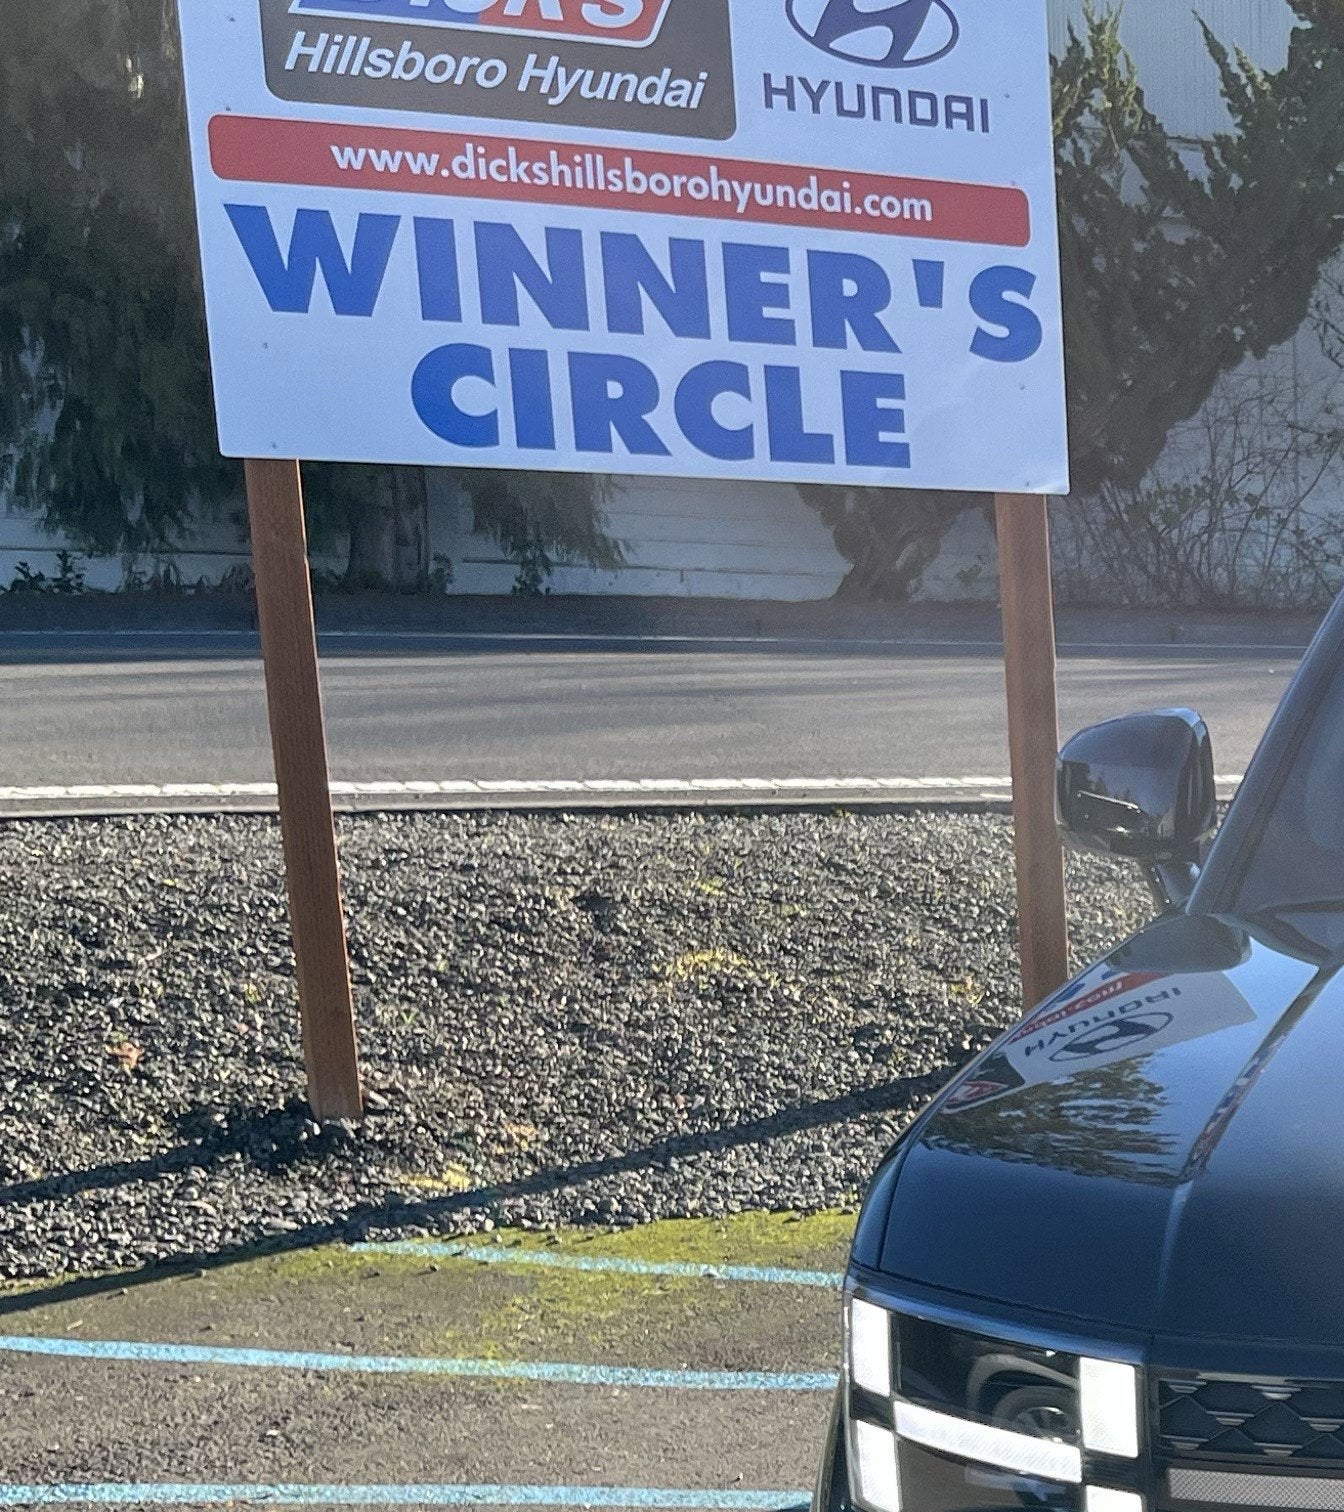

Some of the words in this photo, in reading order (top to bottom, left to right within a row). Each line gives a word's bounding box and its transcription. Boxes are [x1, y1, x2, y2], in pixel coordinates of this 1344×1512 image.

[284, 30, 507, 88] Hillsboro
[517, 54, 708, 109] Hyundai
[763, 72, 989, 134] HYUNDAI
[330, 140, 933, 222] www.dickshillsborohyundai.com
[223, 203, 1042, 362] WINNER'S
[410, 342, 911, 468] CIRCLE
